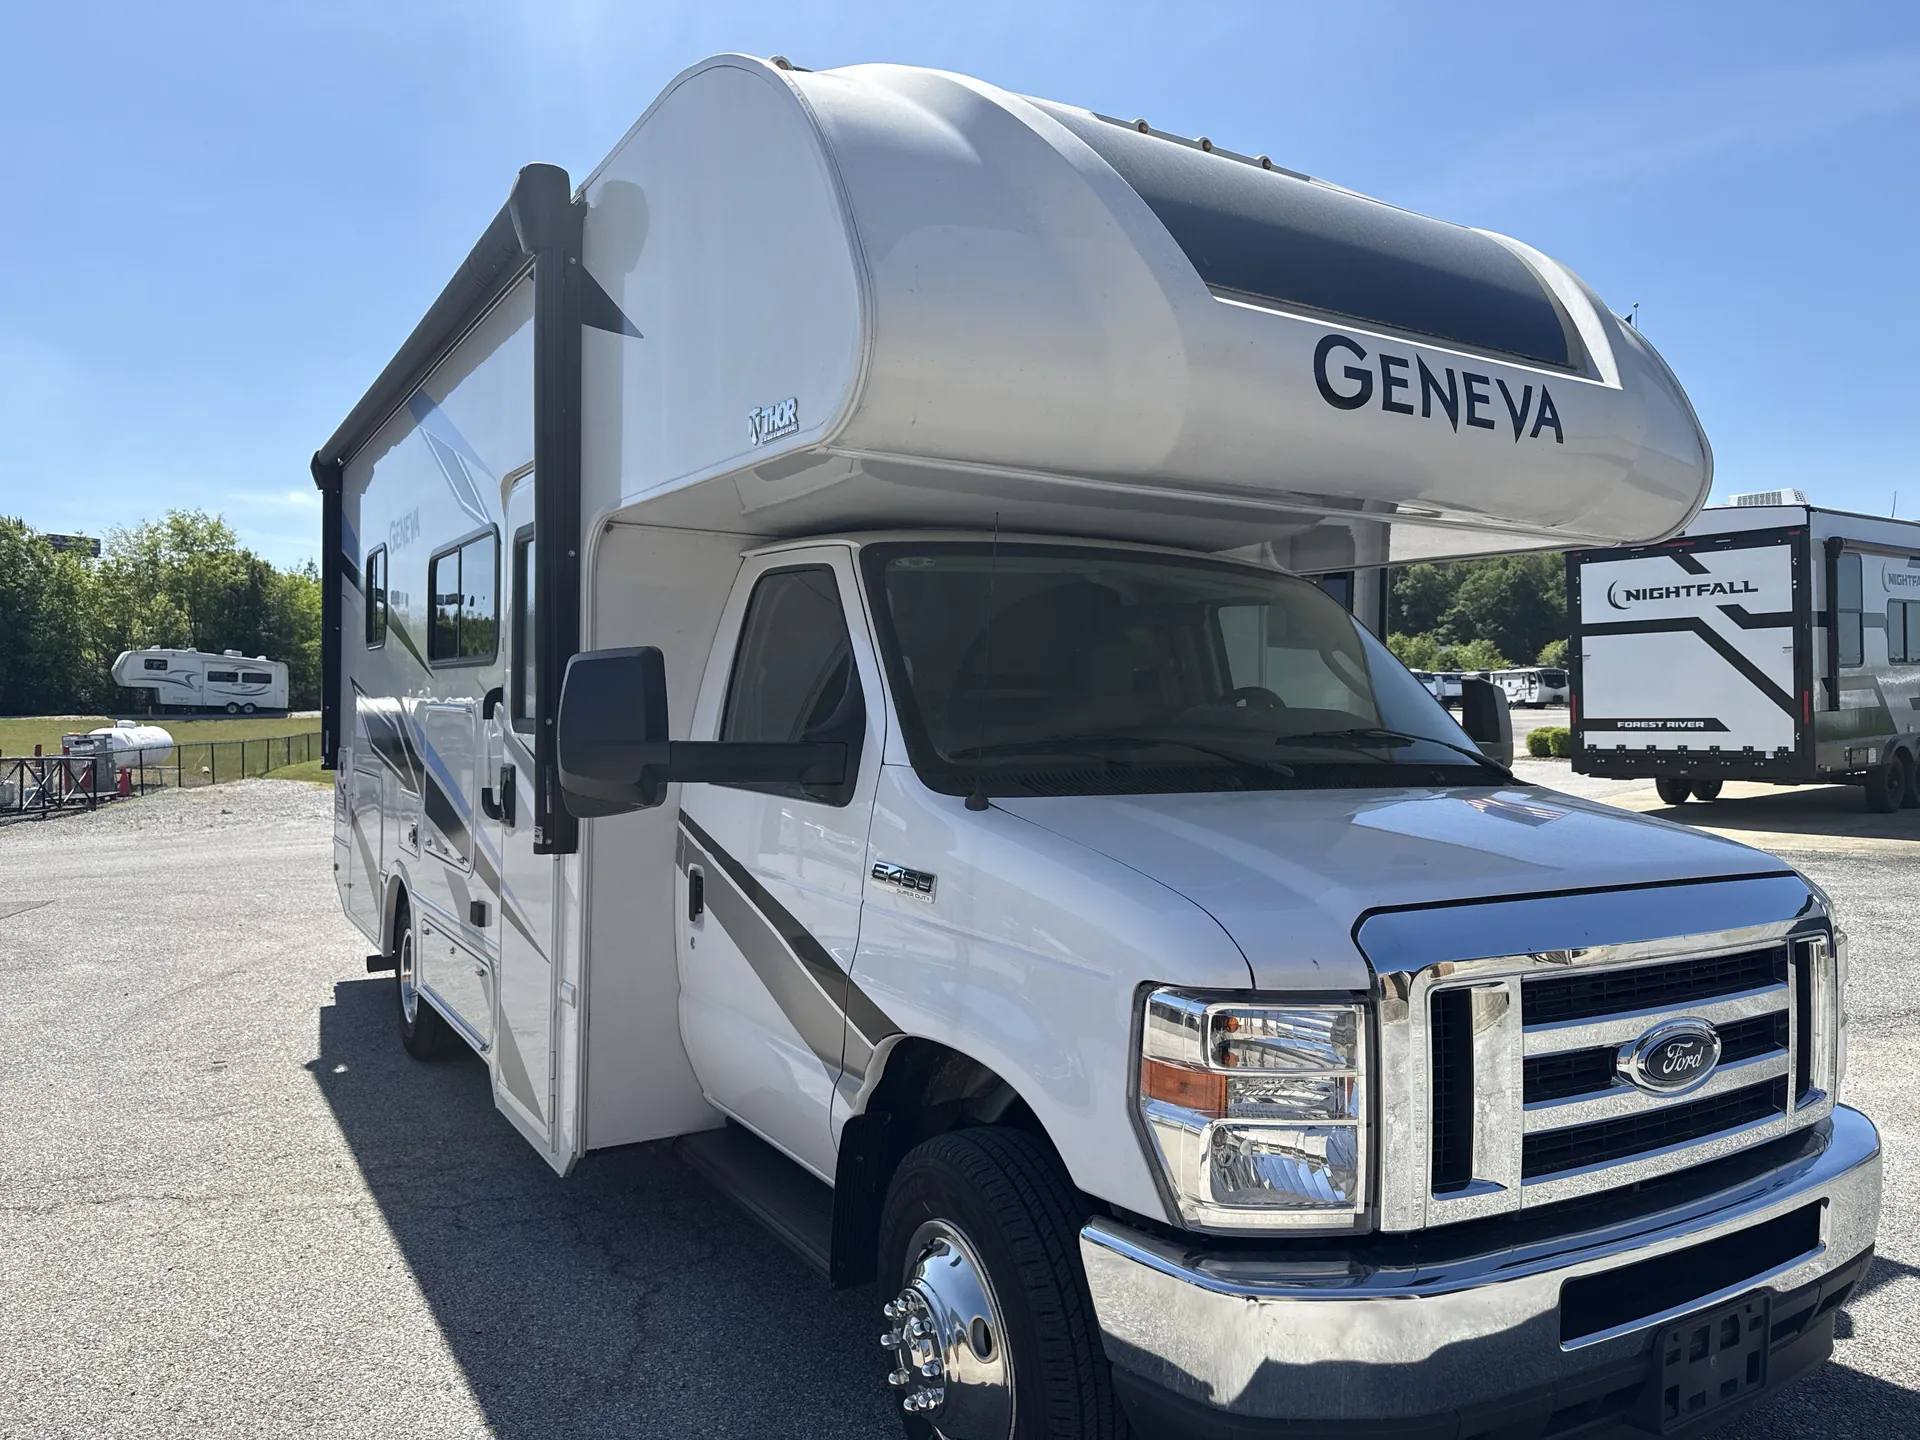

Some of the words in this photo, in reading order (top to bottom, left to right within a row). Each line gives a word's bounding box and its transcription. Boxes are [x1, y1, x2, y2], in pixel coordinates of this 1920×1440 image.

[1313, 333, 1564, 445] GENEVA
[761, 397, 798, 434] THOR
[388, 505, 421, 556] GENEVA
[1623, 580, 1759, 602] NIGHTFALL
[1616, 721, 1665, 729] FOREST
[1666, 721, 1705, 729] RIVER
[896, 888, 914, 897] SUPER
[914, 893, 931, 902] DUTY
[1662, 1041, 1704, 1074] Ford
